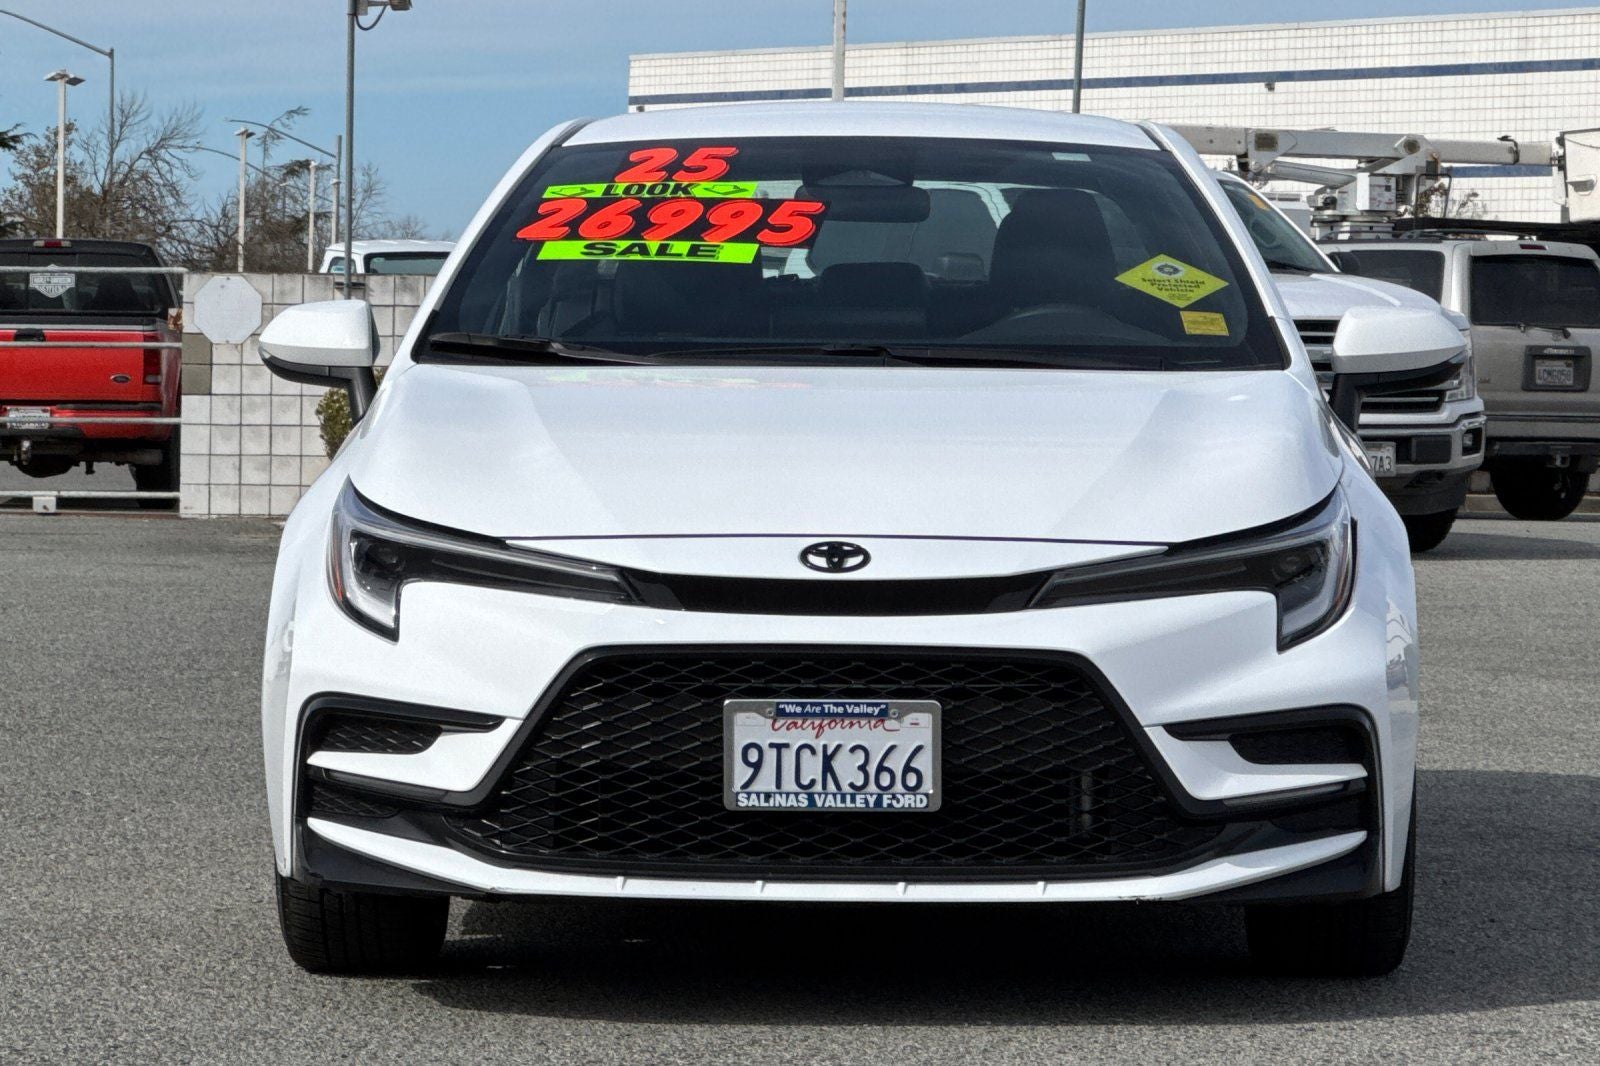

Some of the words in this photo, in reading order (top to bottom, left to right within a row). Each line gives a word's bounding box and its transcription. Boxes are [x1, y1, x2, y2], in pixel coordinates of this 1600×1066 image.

[614, 147, 738, 182] 25
[601, 183, 698, 198] LOOK
[515, 198, 825, 247] 26995
[580, 242, 721, 259] SALE
[804, 705, 822, 714] Are
[823, 705, 845, 714] The
[771, 718, 900, 739] California
[740, 742, 925, 792] 9TCK366
[737, 793, 809, 808] SALINAS
[814, 794, 878, 808] VALLEY
[882, 794, 928, 809] FORD
